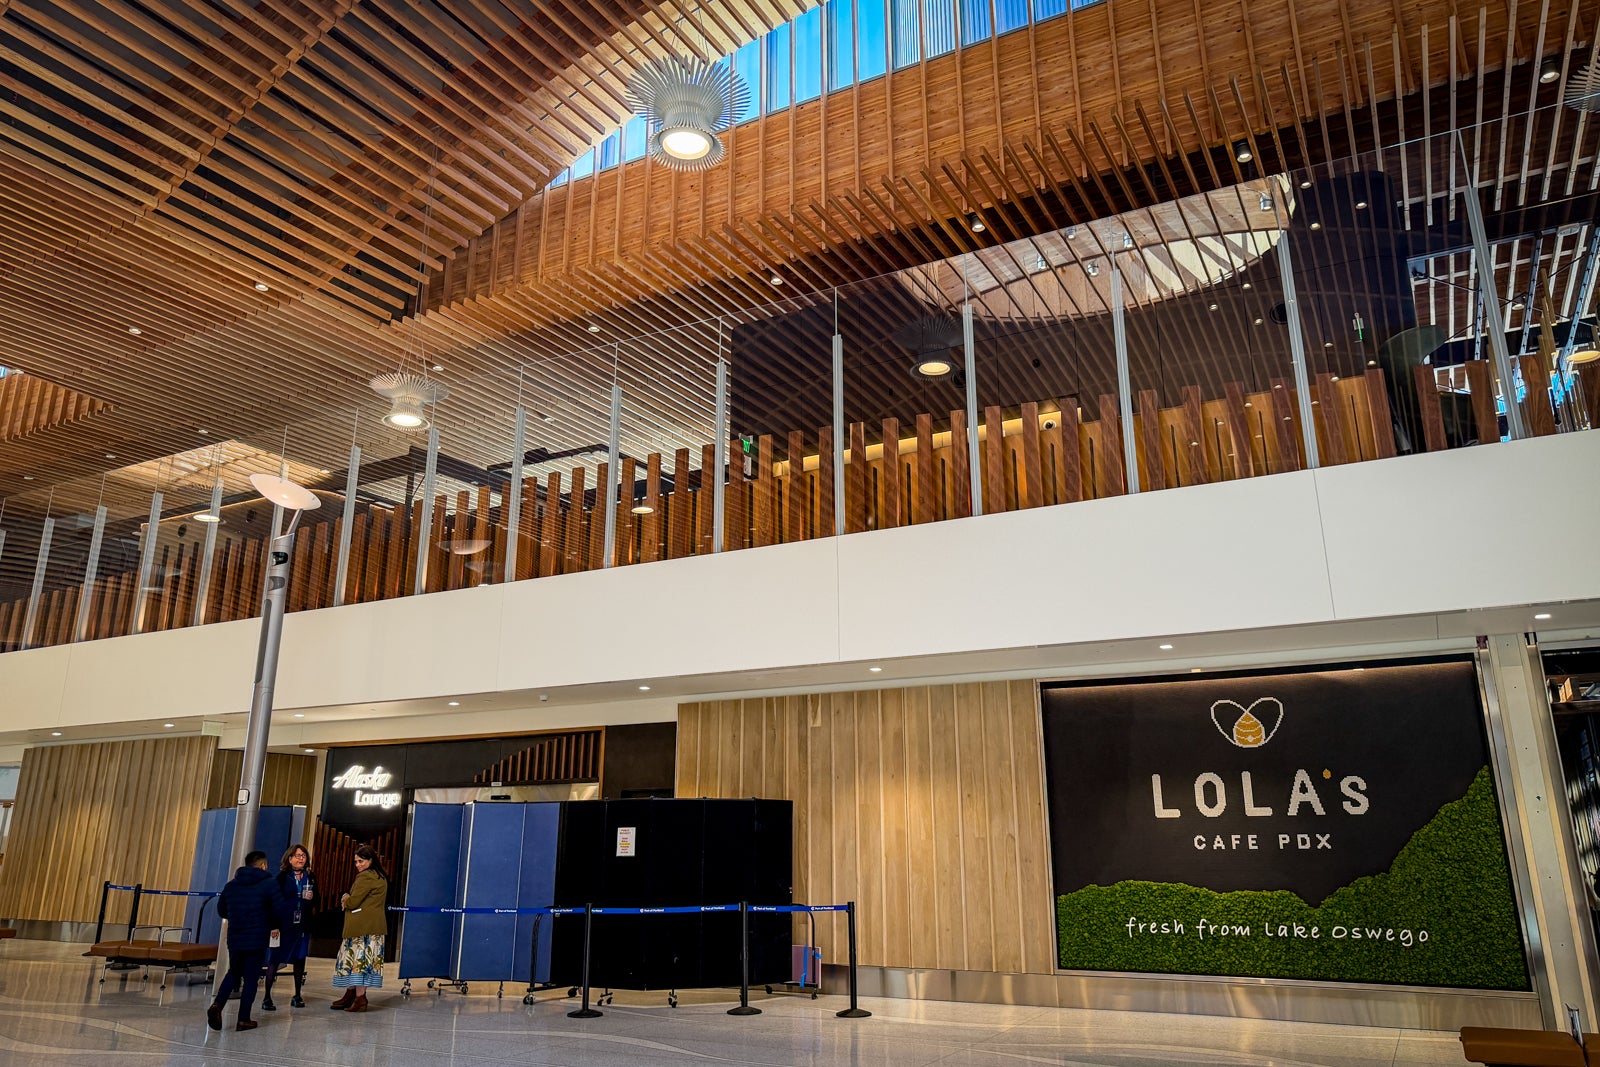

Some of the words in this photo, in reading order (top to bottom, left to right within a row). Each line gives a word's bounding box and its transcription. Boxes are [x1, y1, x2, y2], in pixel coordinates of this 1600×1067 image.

[332, 765, 392, 790] Alaska
[354, 790, 401, 809] Lounge
[1151, 769, 1370, 818] LOLA'S
[1193, 834, 1259, 850] CAFE
[1278, 833, 1332, 850] PDX
[1126, 917, 1185, 937] fresh
[1196, 919, 1251, 940] from
